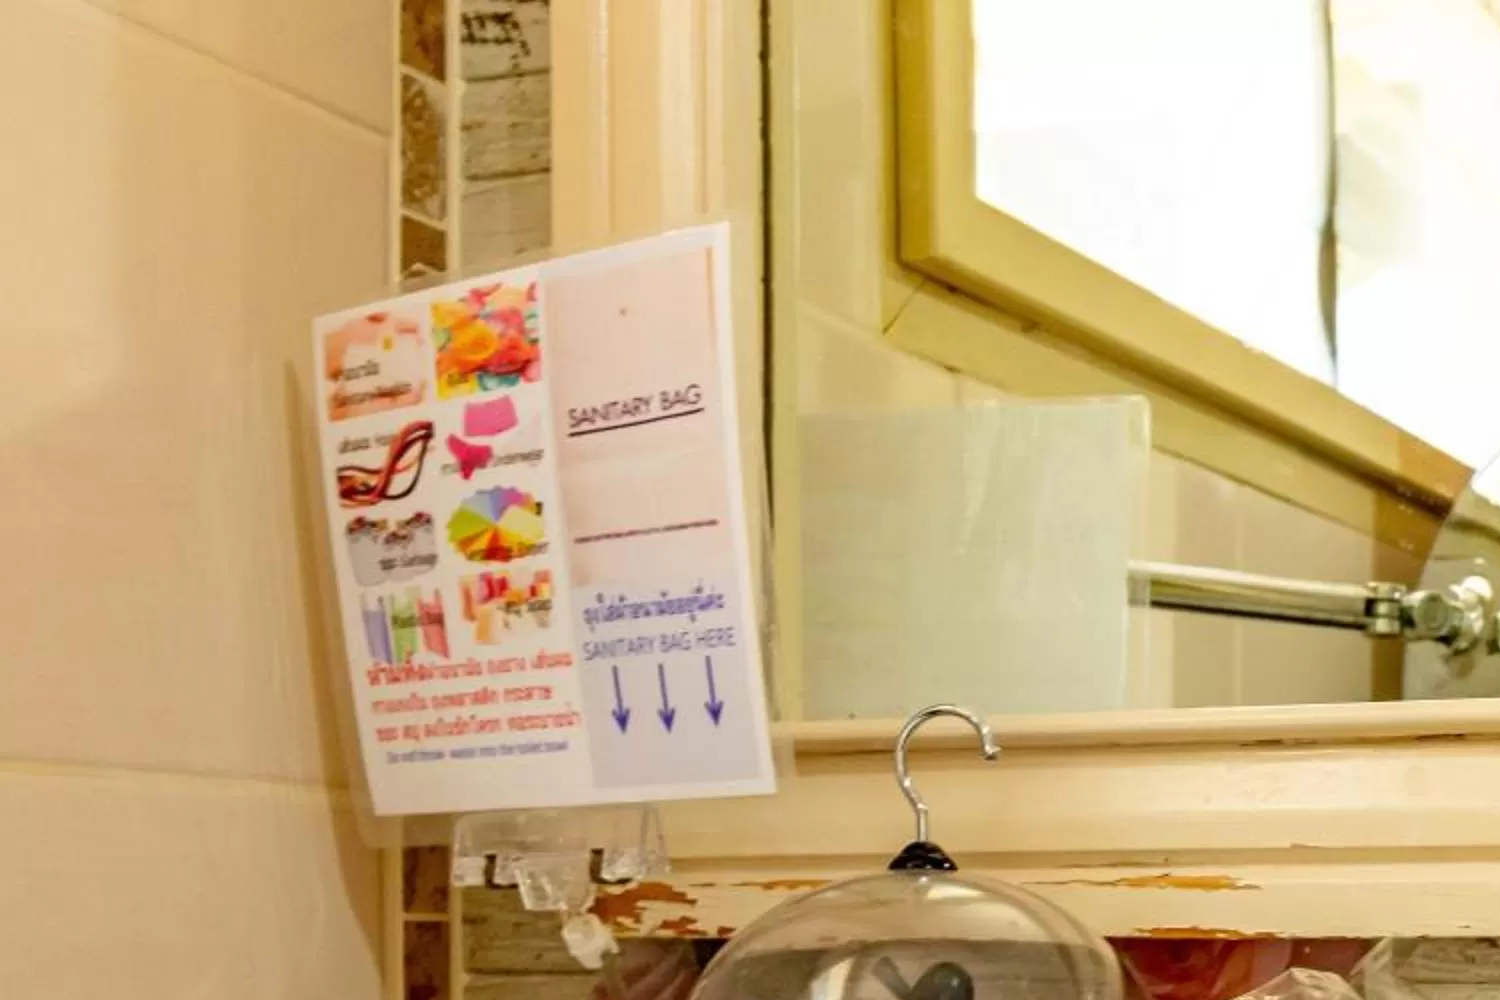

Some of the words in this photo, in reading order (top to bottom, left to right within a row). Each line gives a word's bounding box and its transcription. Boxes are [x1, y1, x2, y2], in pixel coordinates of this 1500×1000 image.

[567, 396, 653, 429] SANITARY
[659, 383, 702, 411] BAG
[582, 637, 654, 661] SANITARY
[659, 631, 691, 653] BAG
[697, 626, 737, 649] HERE
